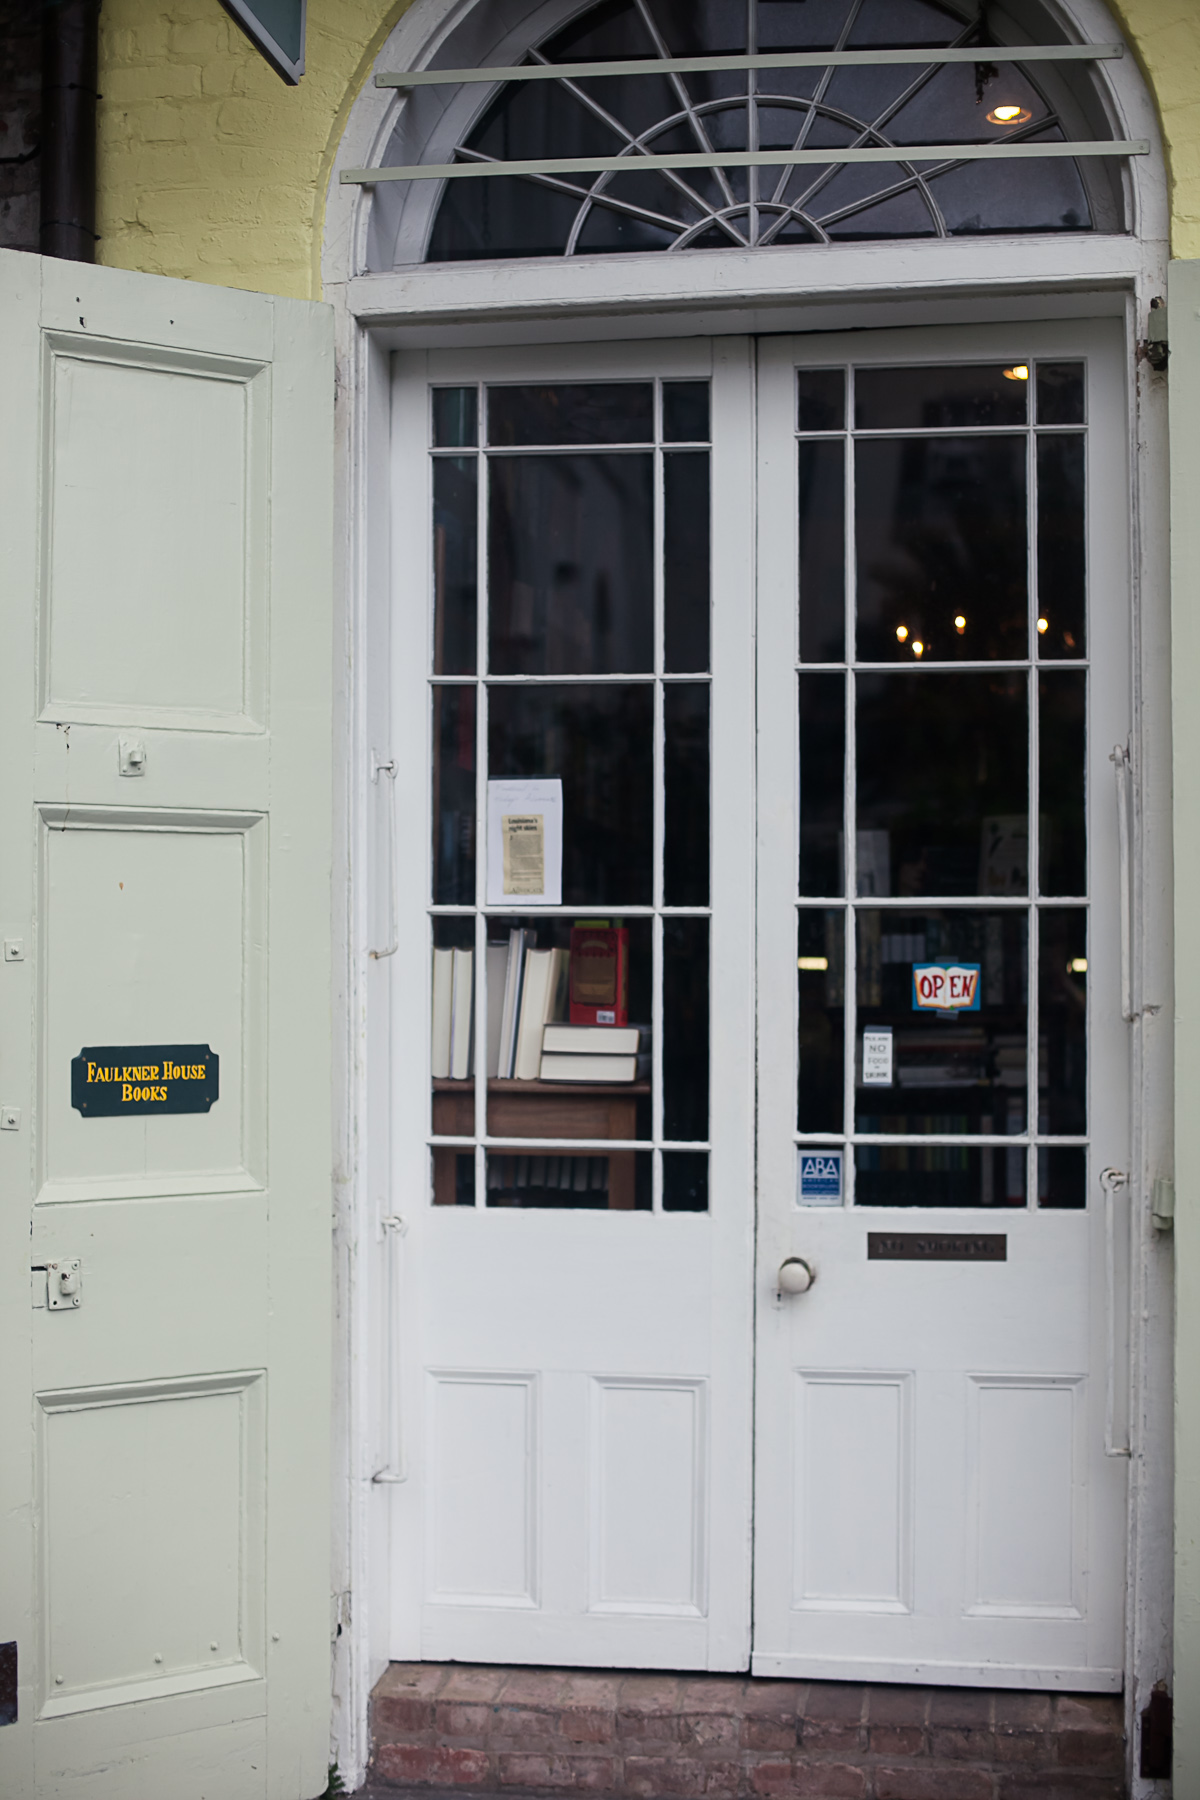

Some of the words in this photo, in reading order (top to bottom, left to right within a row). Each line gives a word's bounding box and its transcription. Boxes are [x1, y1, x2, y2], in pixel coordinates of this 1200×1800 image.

[920, 974, 974, 998] OPEN
[869, 1044, 886, 1053] NO
[86, 1062, 160, 1083] FAULKNER
[161, 1061, 206, 1080] HOUSE
[121, 1083, 168, 1102] BOOKS
[802, 1157, 838, 1178] ABA
[878, 1240, 904, 1254] NO
[915, 1240, 996, 1254] SMOKING
